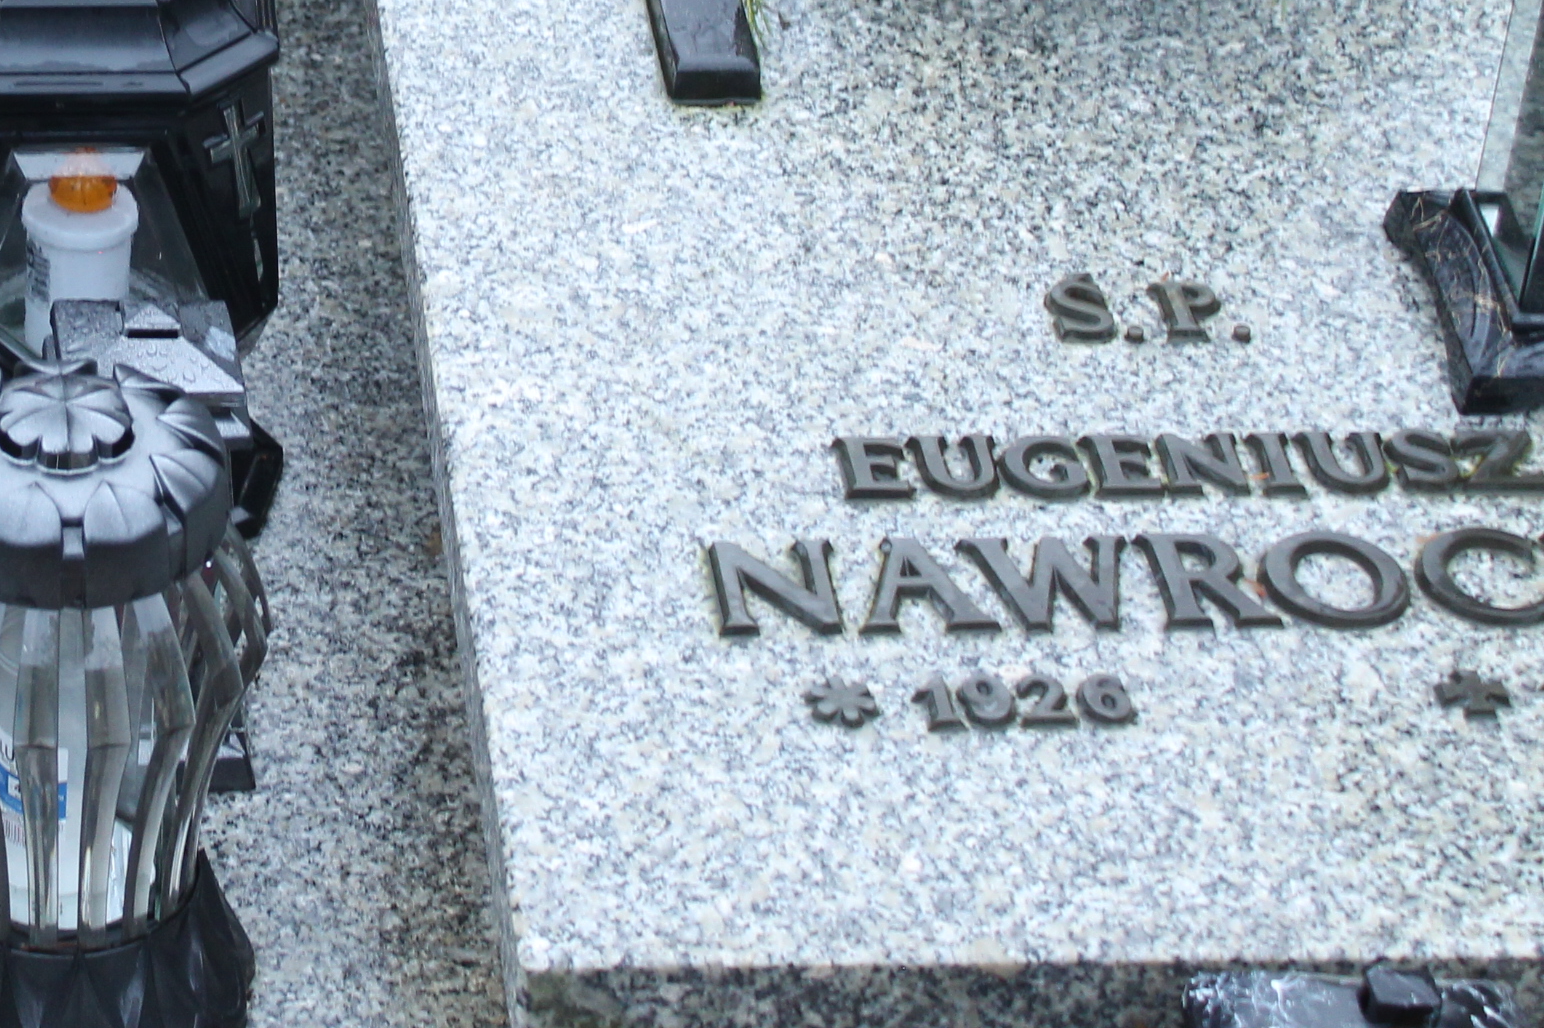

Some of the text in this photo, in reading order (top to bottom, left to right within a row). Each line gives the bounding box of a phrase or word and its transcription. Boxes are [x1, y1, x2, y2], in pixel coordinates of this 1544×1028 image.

[830, 431, 1544, 501] EUGENIUSZ
[706, 527, 1544, 638] NAWROC
[911, 673, 1138, 733] 1926
